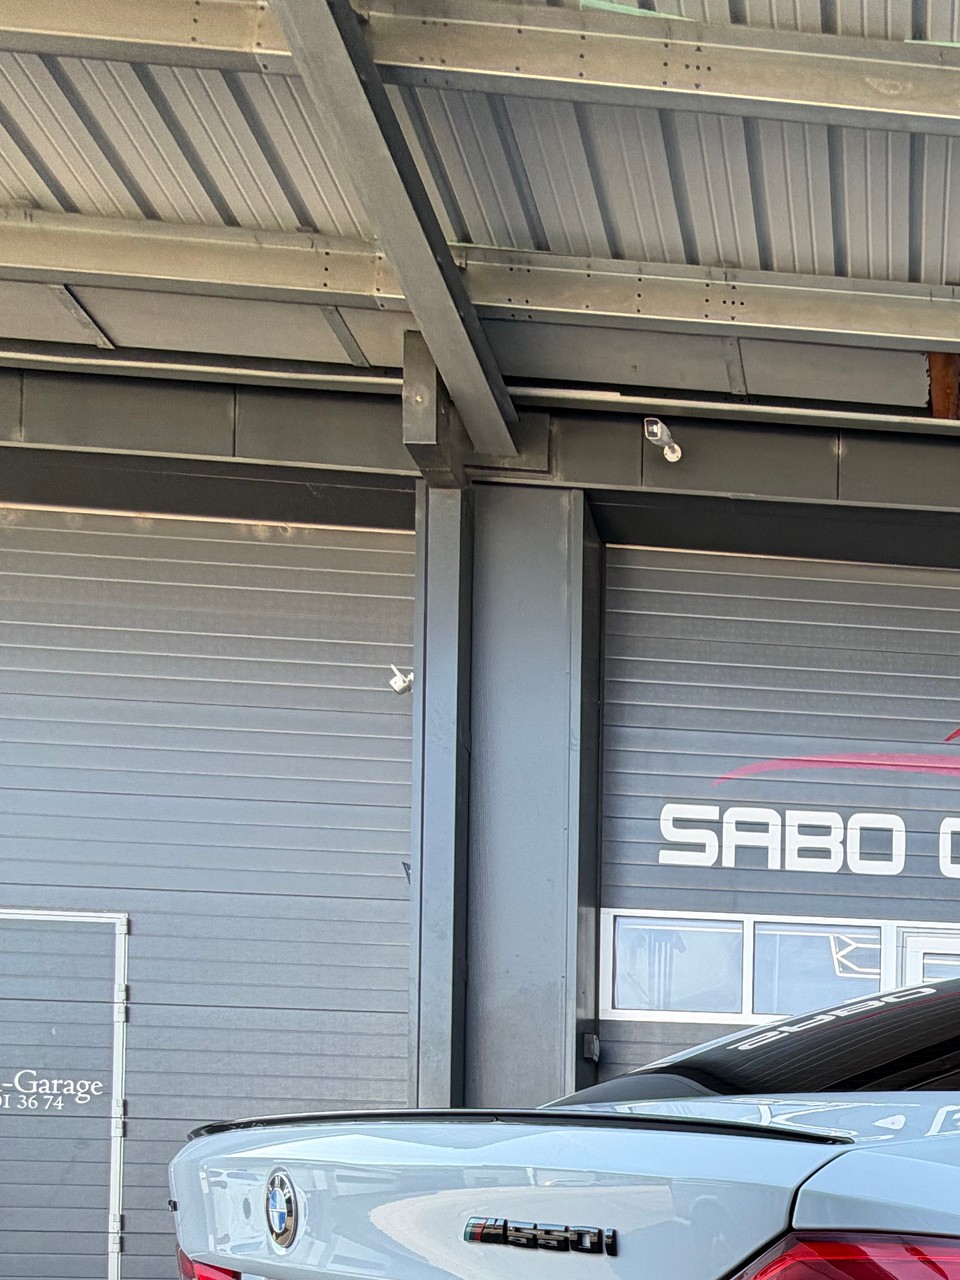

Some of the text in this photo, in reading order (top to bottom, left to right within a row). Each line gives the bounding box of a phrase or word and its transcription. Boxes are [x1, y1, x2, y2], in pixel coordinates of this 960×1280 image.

[659, 803, 906, 876] SABO
[0, 1069, 104, 1104] -Garage
[17, 1094, 39, 1110] 36
[43, 1095, 65, 1110] 74
